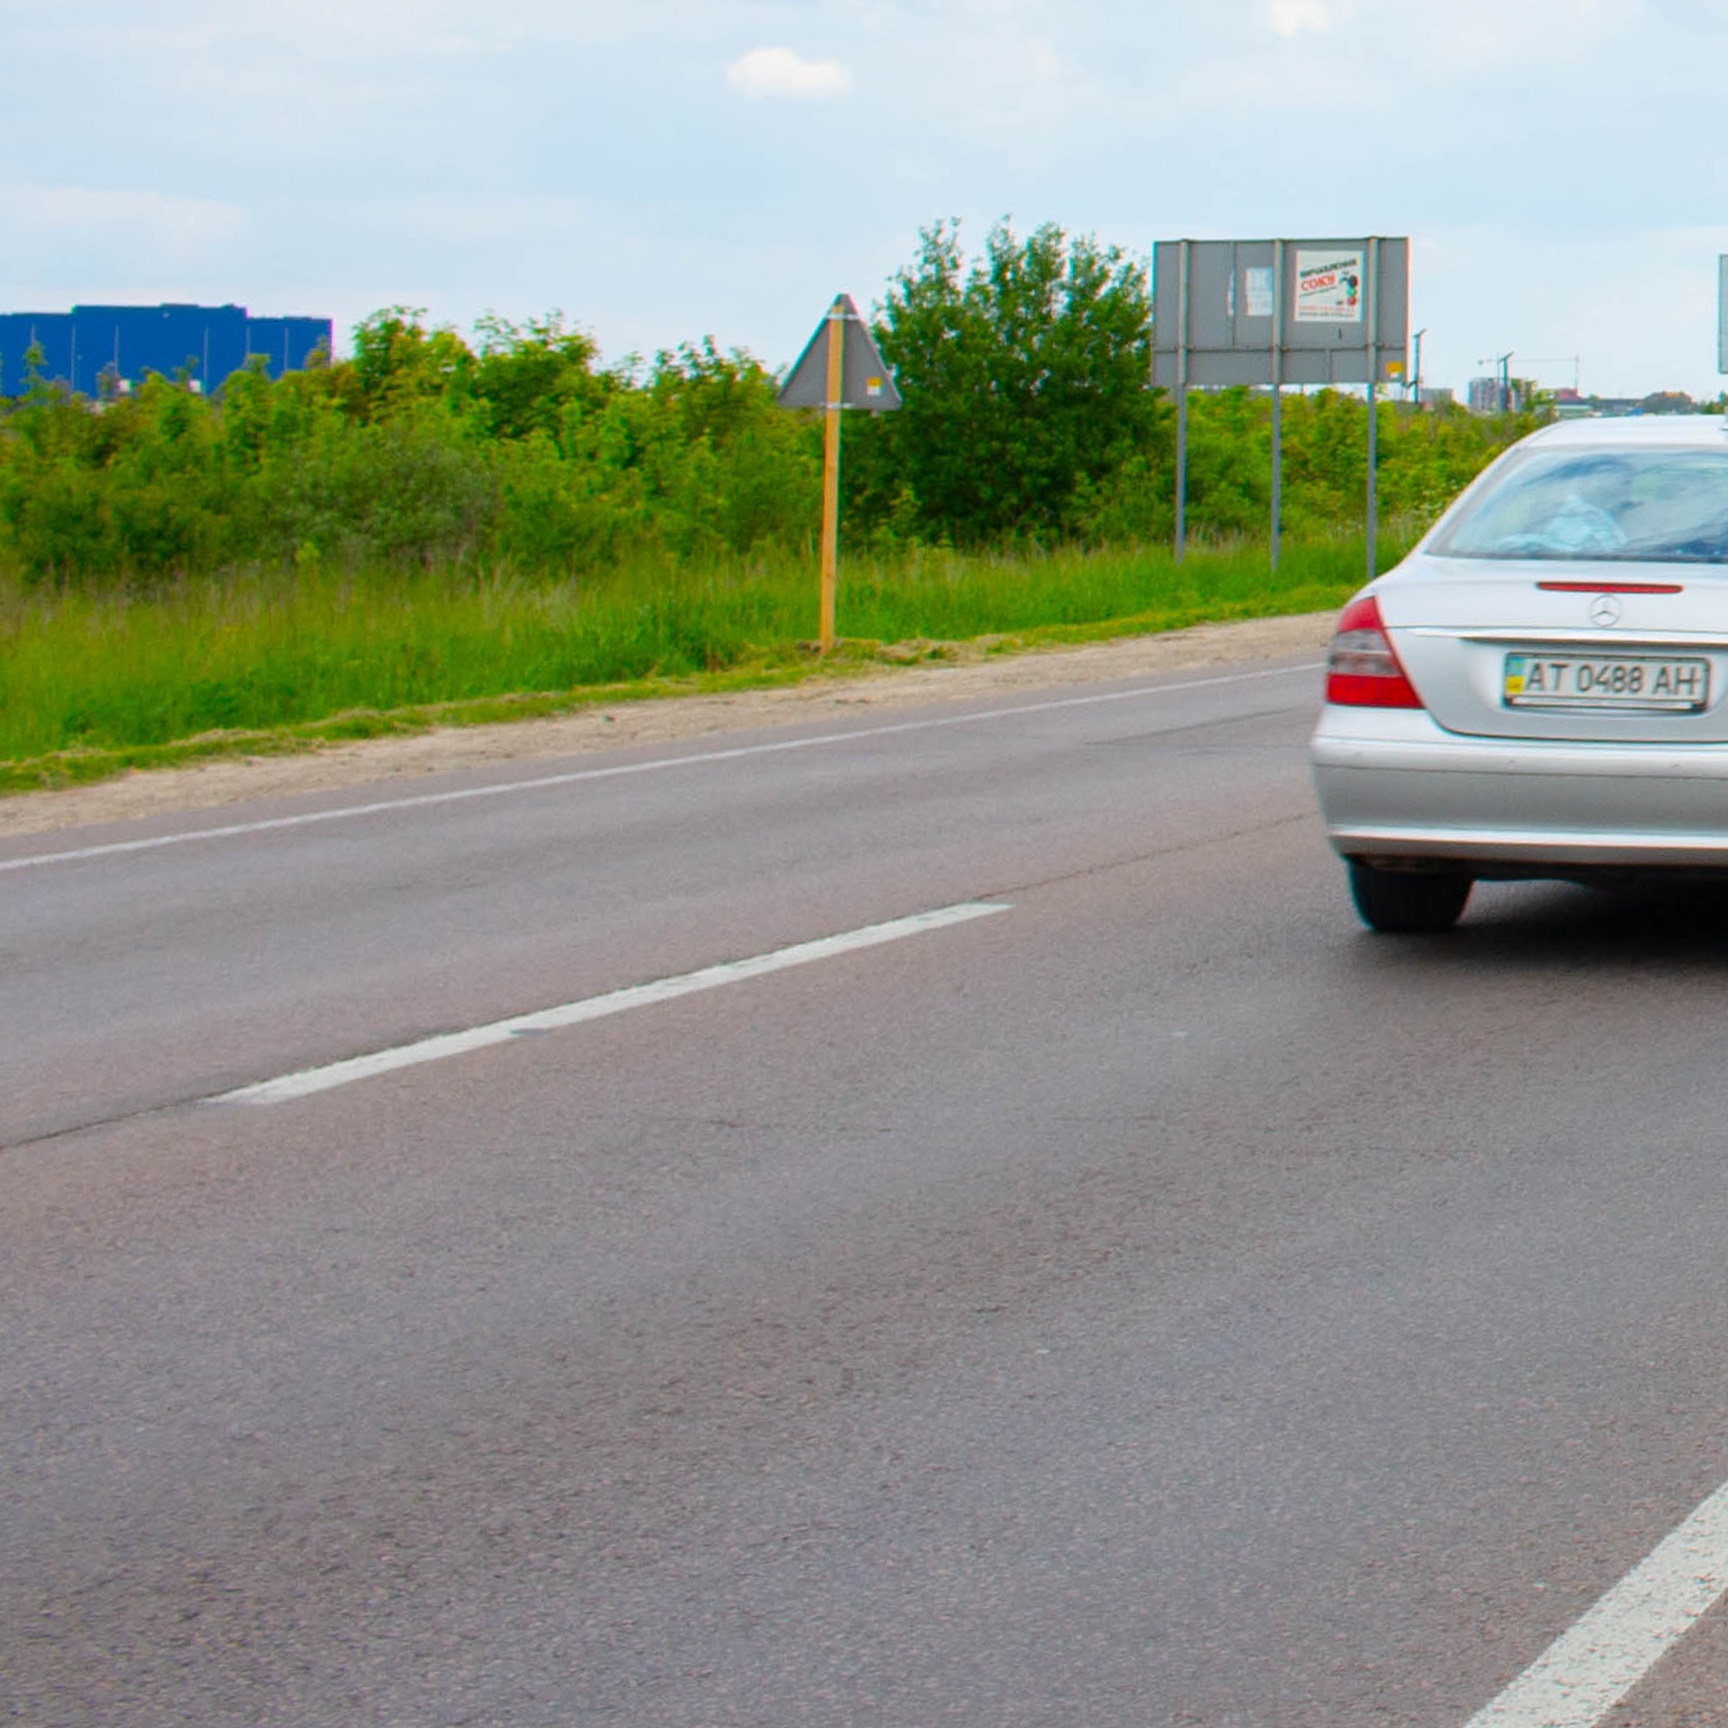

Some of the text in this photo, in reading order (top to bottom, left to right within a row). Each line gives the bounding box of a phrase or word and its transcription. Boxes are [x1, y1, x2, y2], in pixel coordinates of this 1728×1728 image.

[1526, 662, 1699, 695] AT 0488 AH
